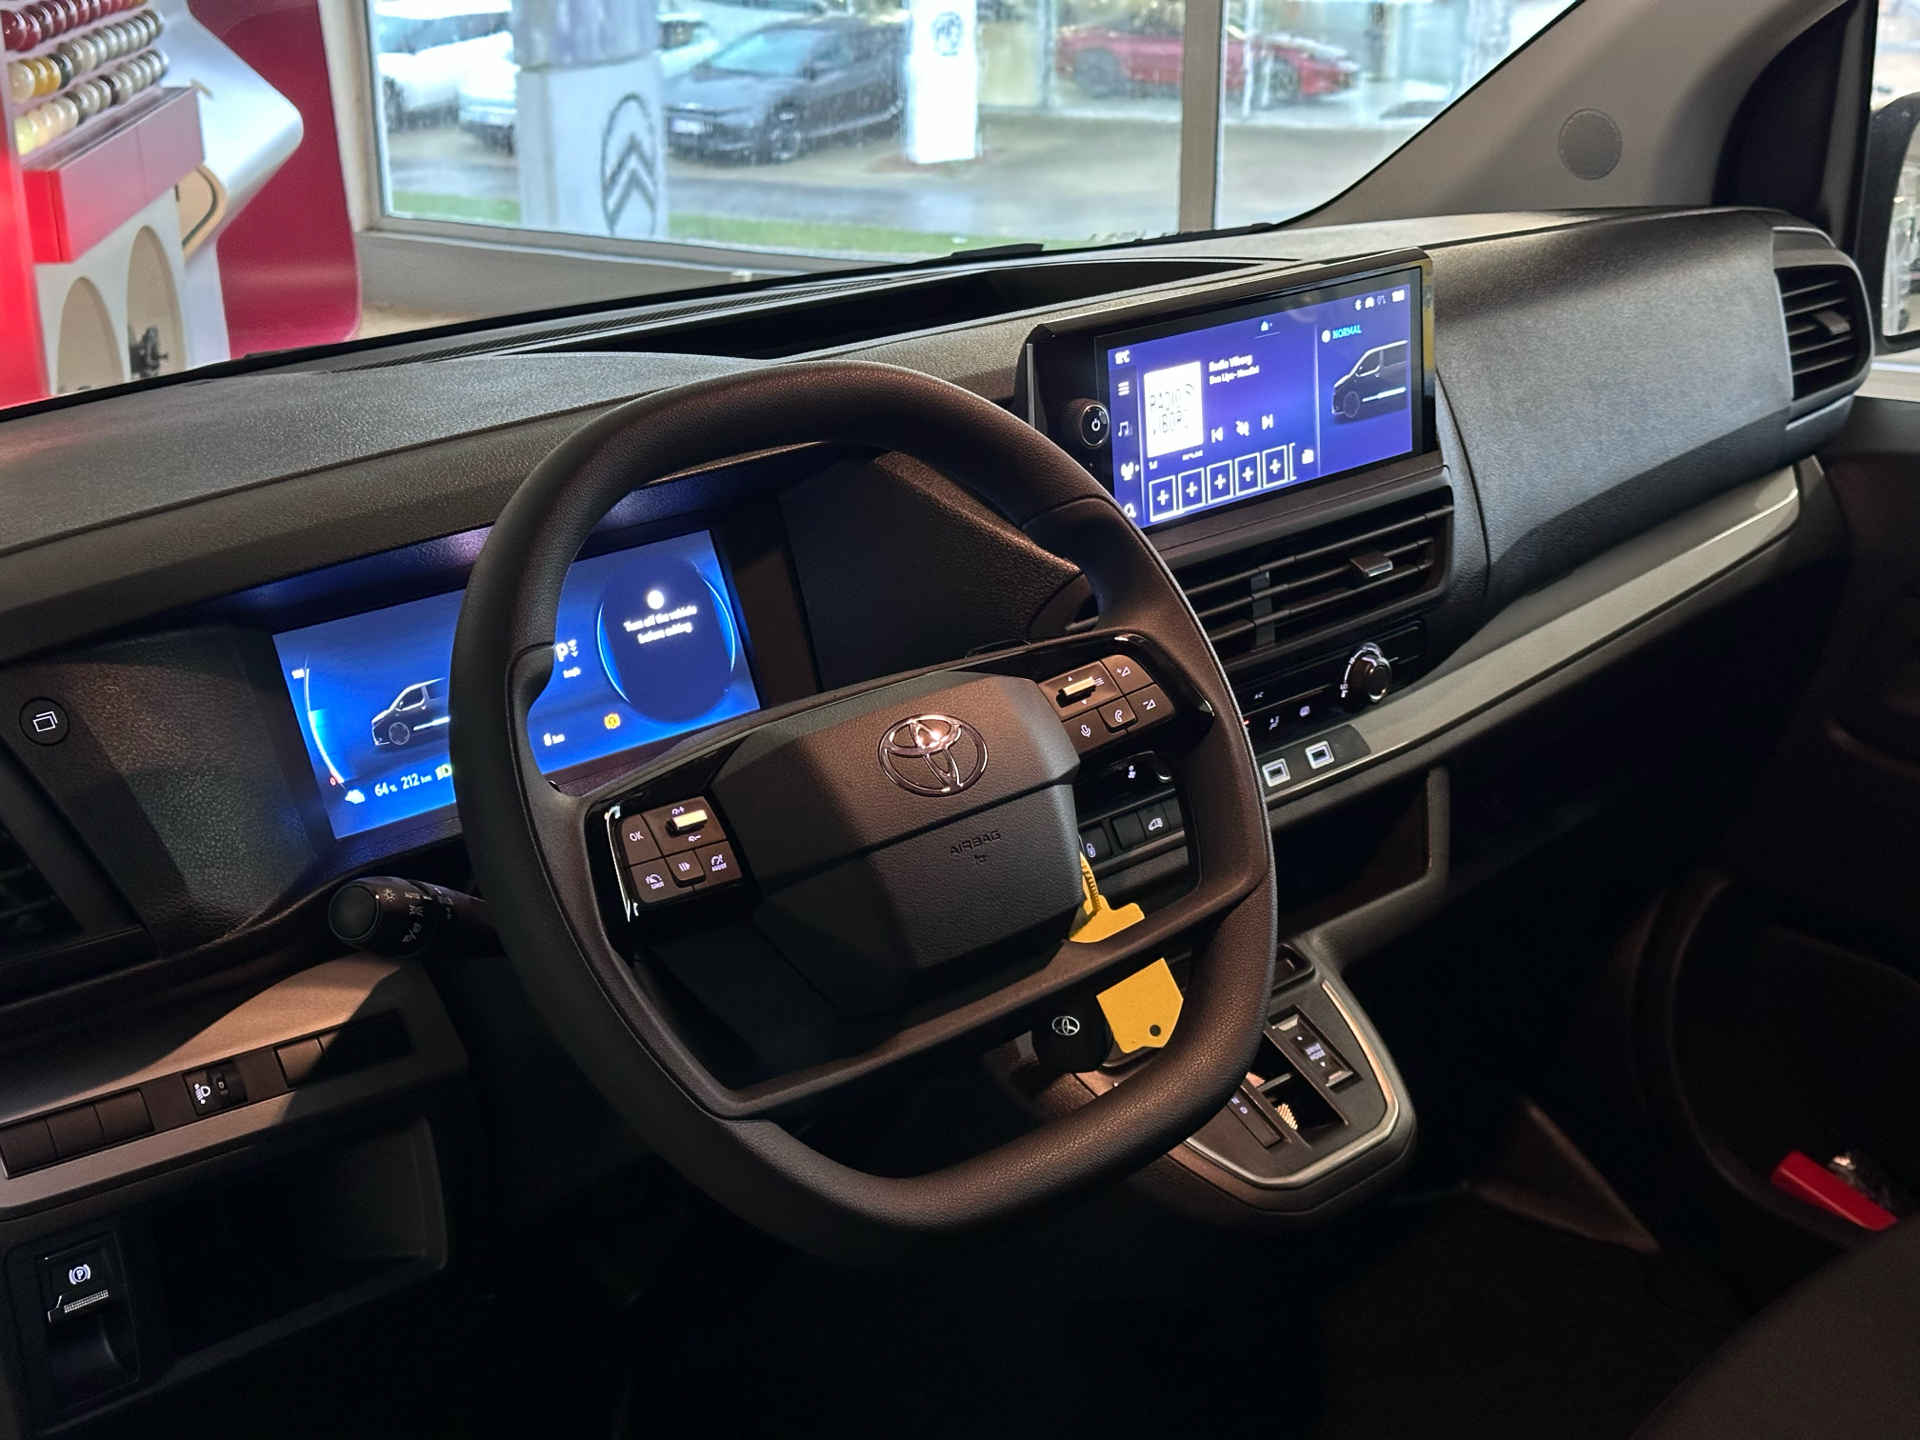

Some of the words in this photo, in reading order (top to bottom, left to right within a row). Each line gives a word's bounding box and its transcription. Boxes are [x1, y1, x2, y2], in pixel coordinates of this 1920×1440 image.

[1332, 325, 1362, 340] NORMAL
[1209, 359, 1229, 372] Radio
[1150, 388, 1182, 414] RADIO
[623, 620, 644, 632] Turn
[655, 613, 670, 624] the
[669, 605, 697, 620] vehicle
[555, 642, 569, 662] P
[374, 782, 389, 797] 64
[401, 773, 420, 790] 212
[421, 775, 432, 784] km
[629, 831, 644, 842] OK
[950, 830, 1001, 854] AIRBAG
